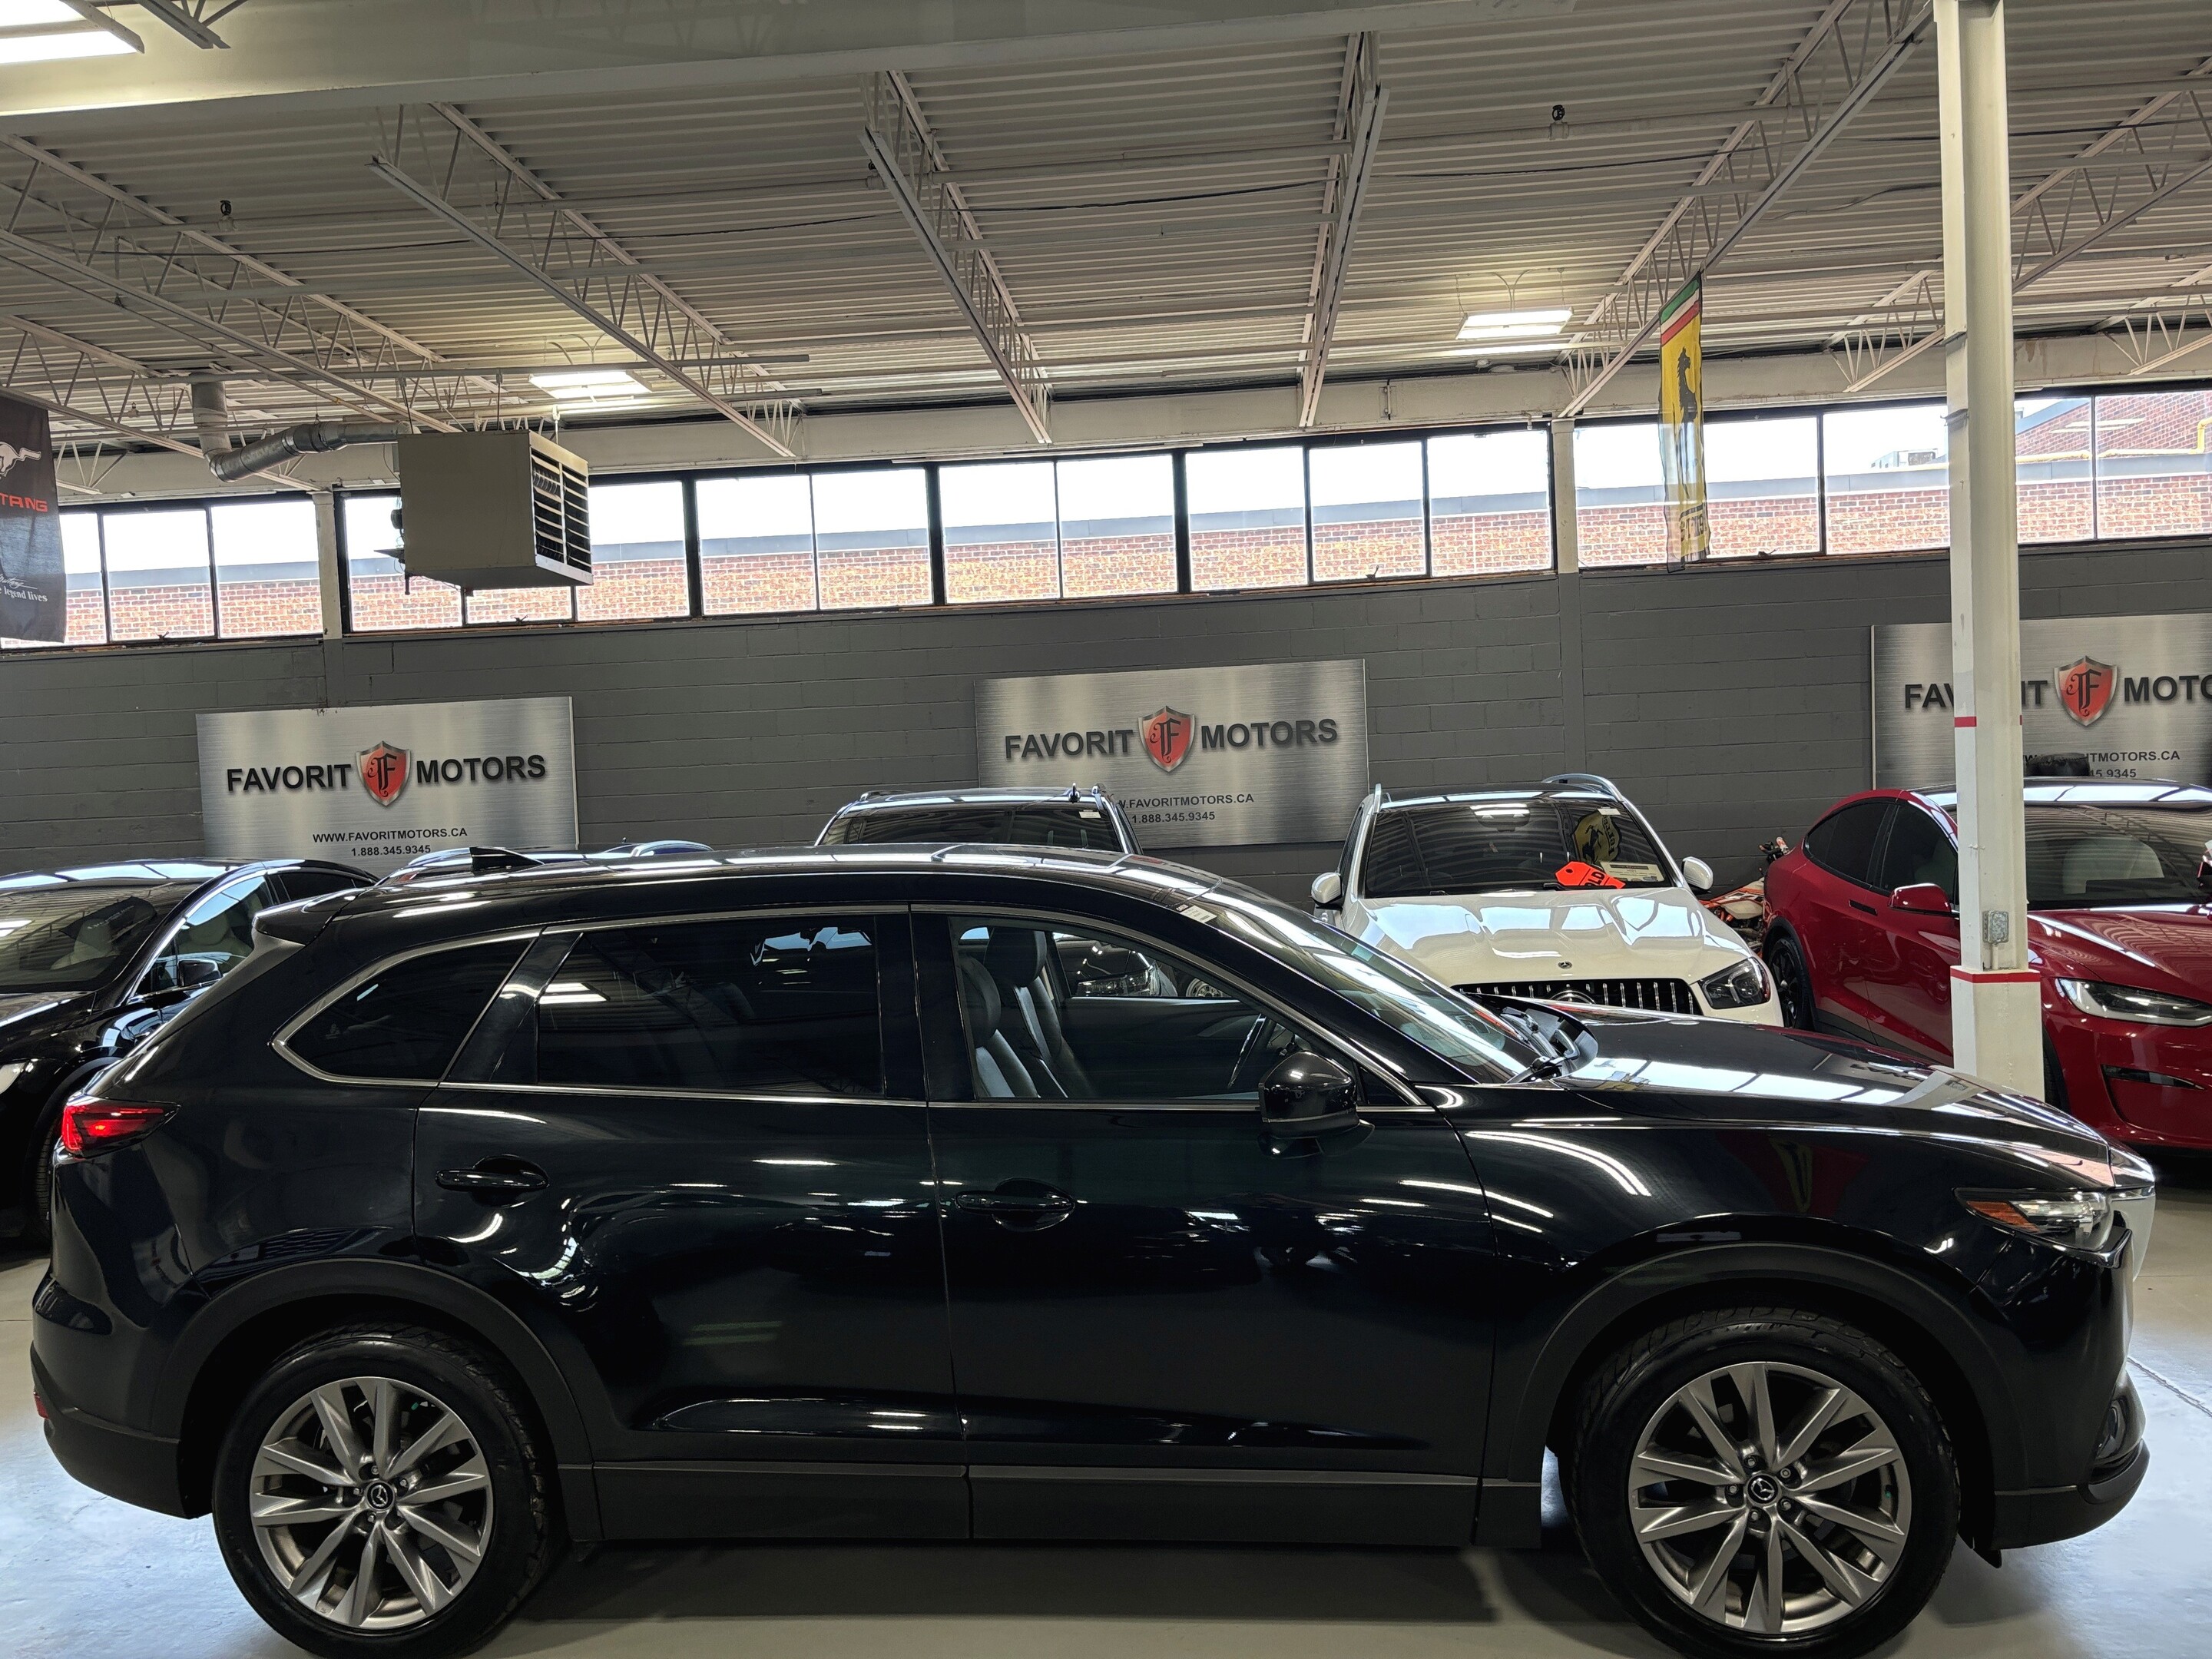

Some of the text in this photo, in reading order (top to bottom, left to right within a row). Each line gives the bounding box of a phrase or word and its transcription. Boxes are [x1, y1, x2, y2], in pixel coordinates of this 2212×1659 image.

[4, 585, 27, 599] legend
[28, 591, 48, 602] lives
[1904, 680, 2048, 708] FAIT
[1005, 729, 1133, 759] FAVORIT
[1201, 718, 1338, 749] MOTORS
[227, 763, 352, 792] FAVORIT
[416, 755, 546, 783] MOTORS
[1131, 811, 1216, 823] 1.888.345.9345
[313, 827, 468, 843] WWW.FAVORITMOTORS.CA
[351, 845, 431, 856] 1.888.345.9345
